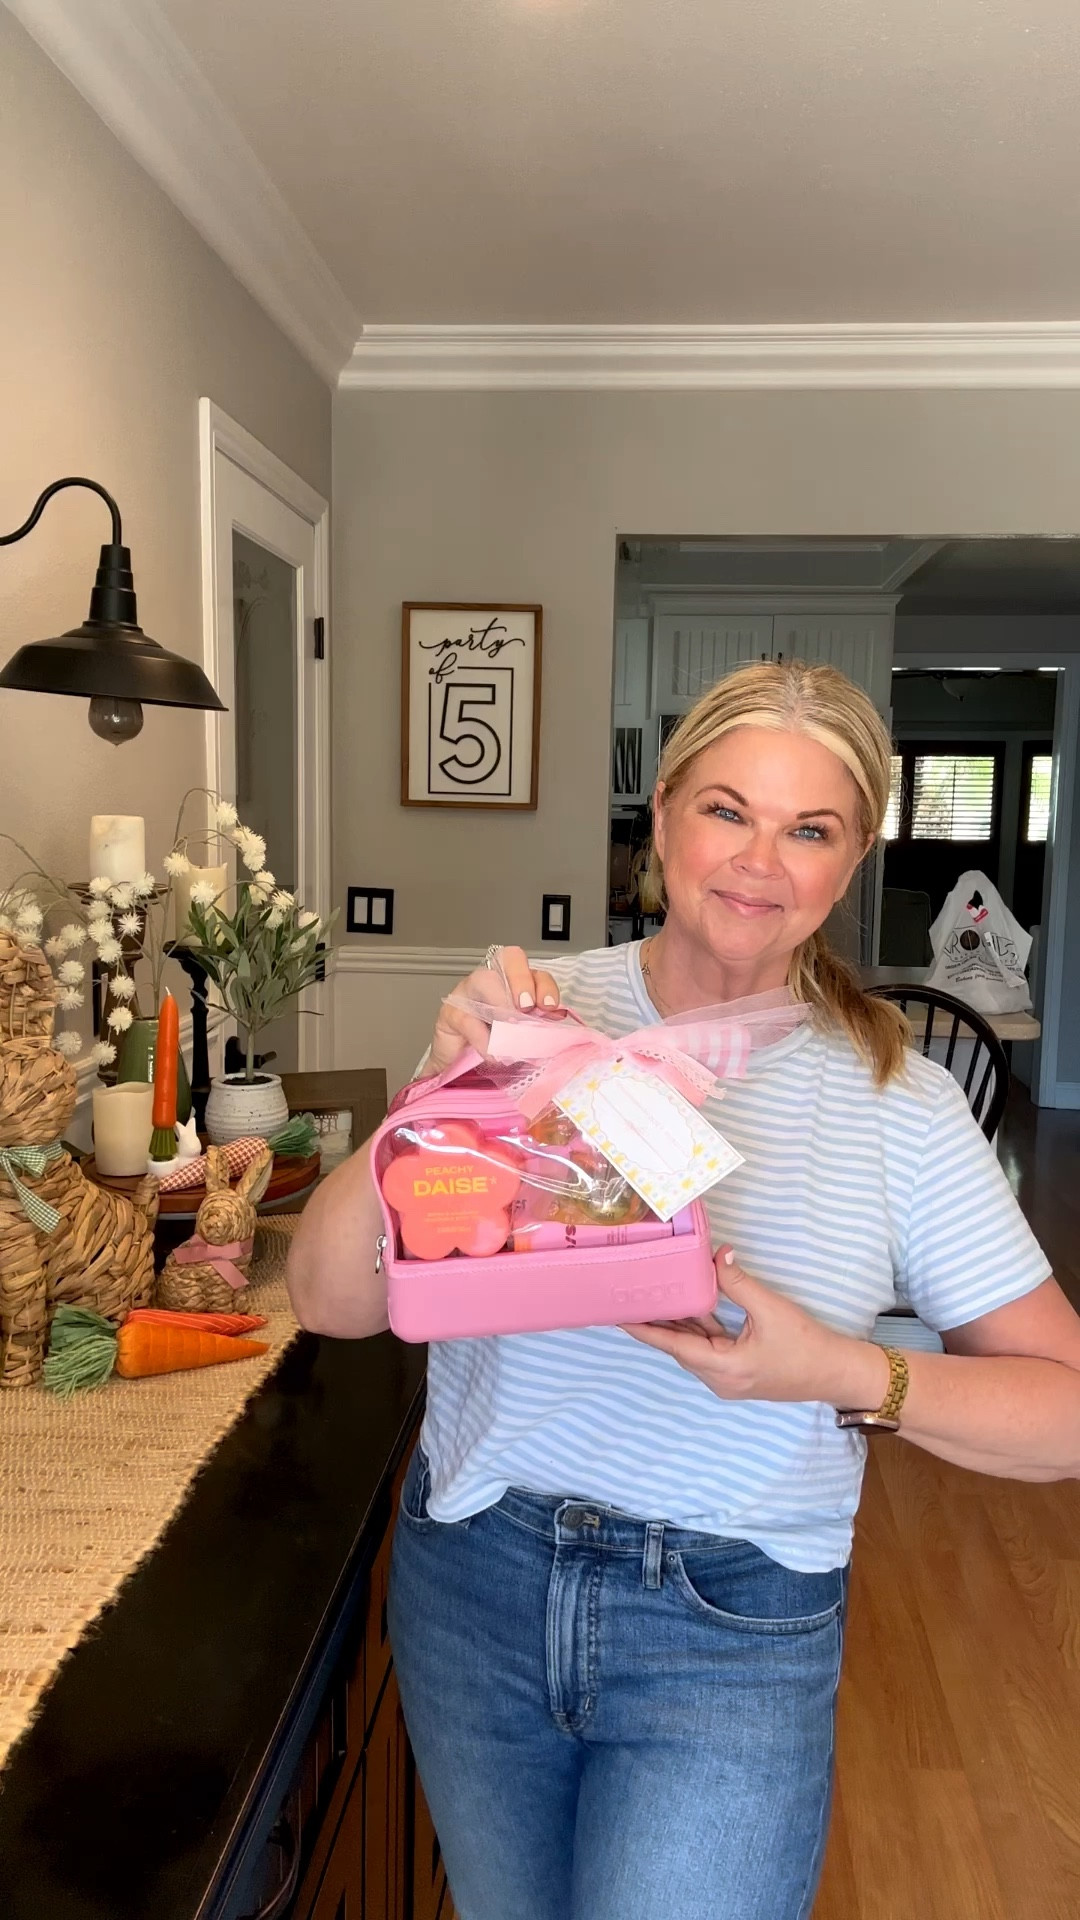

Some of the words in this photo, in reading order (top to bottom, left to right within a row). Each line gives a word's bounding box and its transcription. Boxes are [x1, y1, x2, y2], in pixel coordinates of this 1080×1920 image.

[419, 617, 526, 658] party
[428, 652, 457, 684] of
[438, 682, 502, 785] 5
[413, 1176, 489, 1197] DAISE
[425, 1165, 474, 1176] PEACHY
